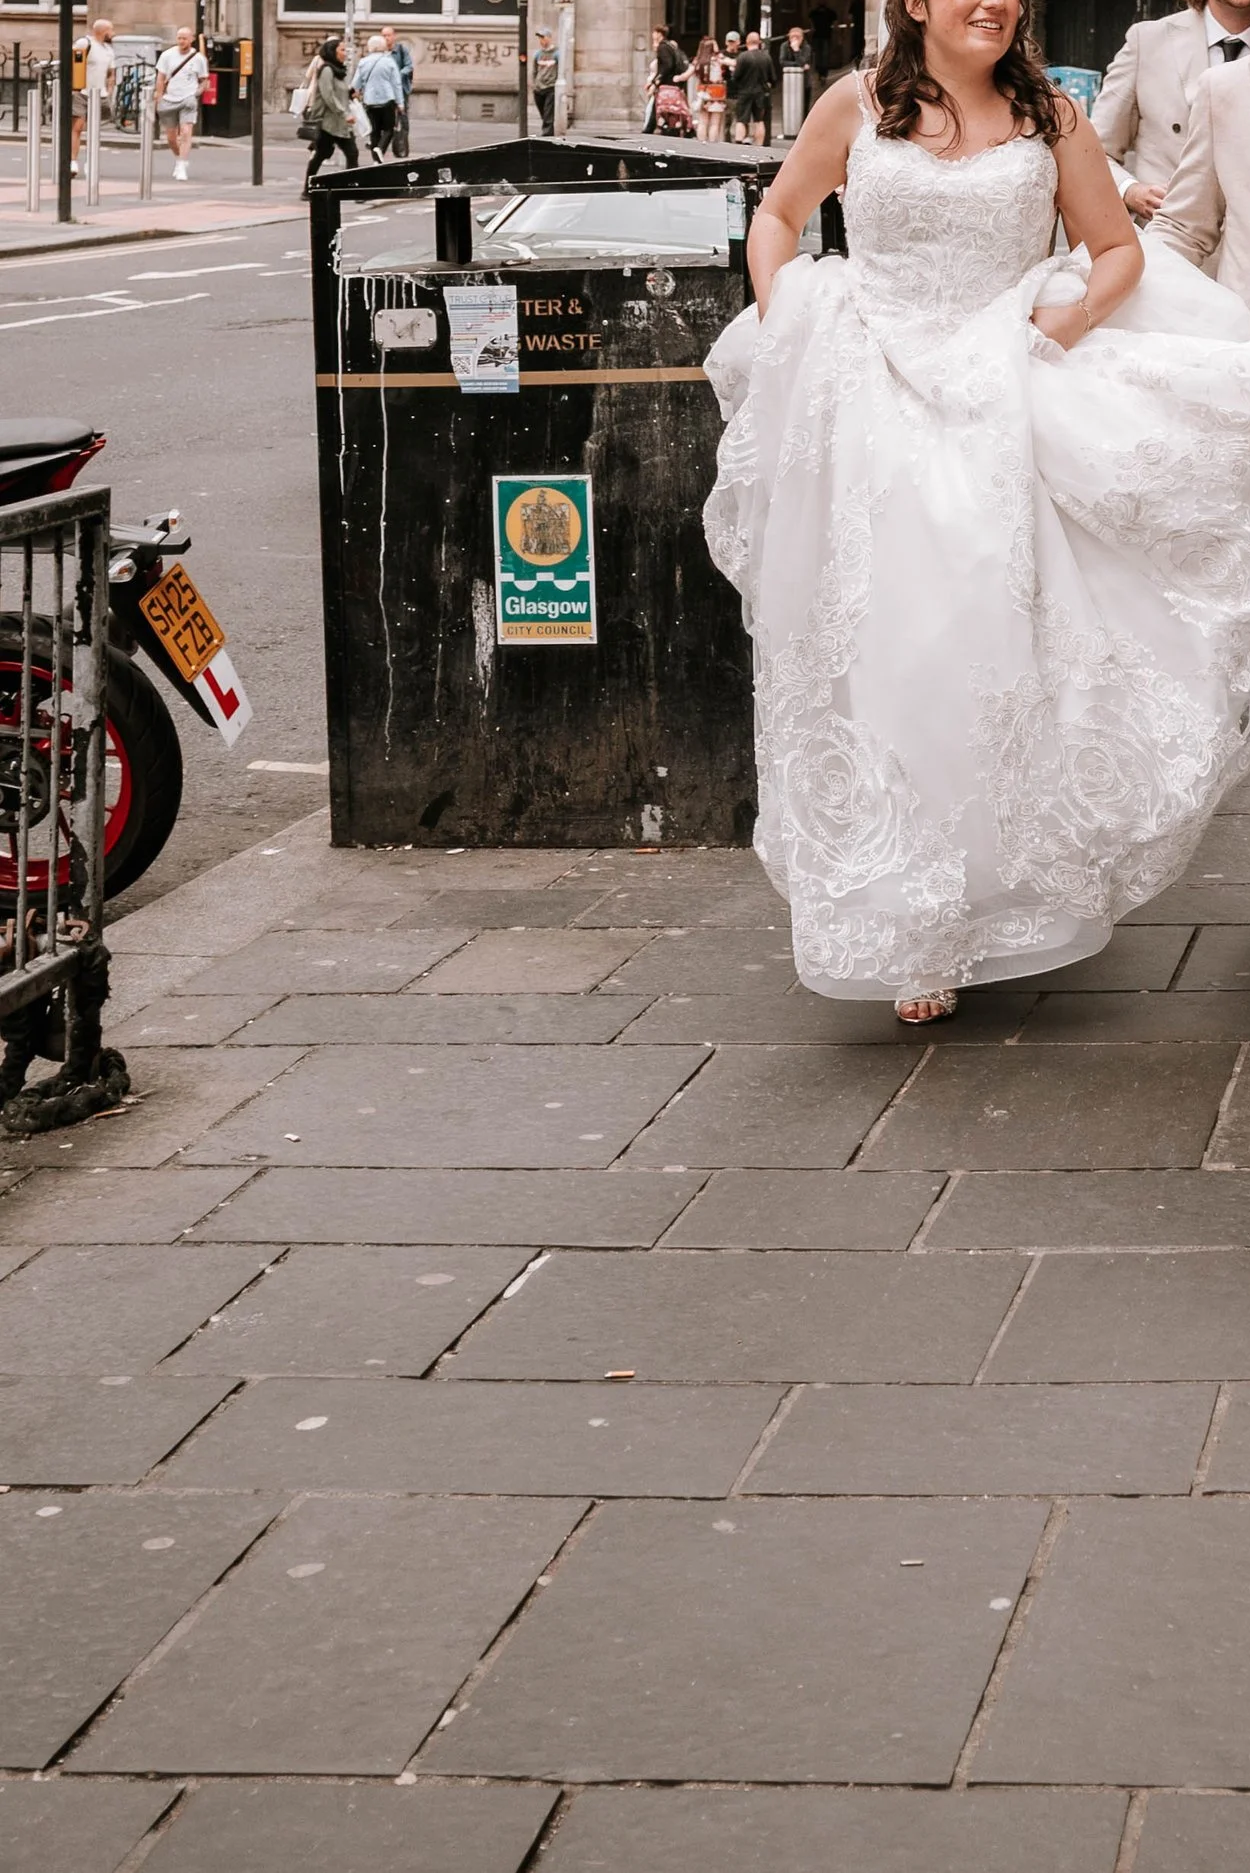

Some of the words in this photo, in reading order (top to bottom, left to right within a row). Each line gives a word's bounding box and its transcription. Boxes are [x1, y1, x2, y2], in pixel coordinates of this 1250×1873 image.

[568, 298, 583, 315] &
[525, 333, 602, 351] WASTE
[147, 571, 197, 636] SH25
[505, 596, 588, 618] Glasgow
[172, 611, 215, 667] FZB
[507, 626, 532, 635] CITY
[536, 626, 586, 635] COUNCIL
[202, 666, 240, 721] L
